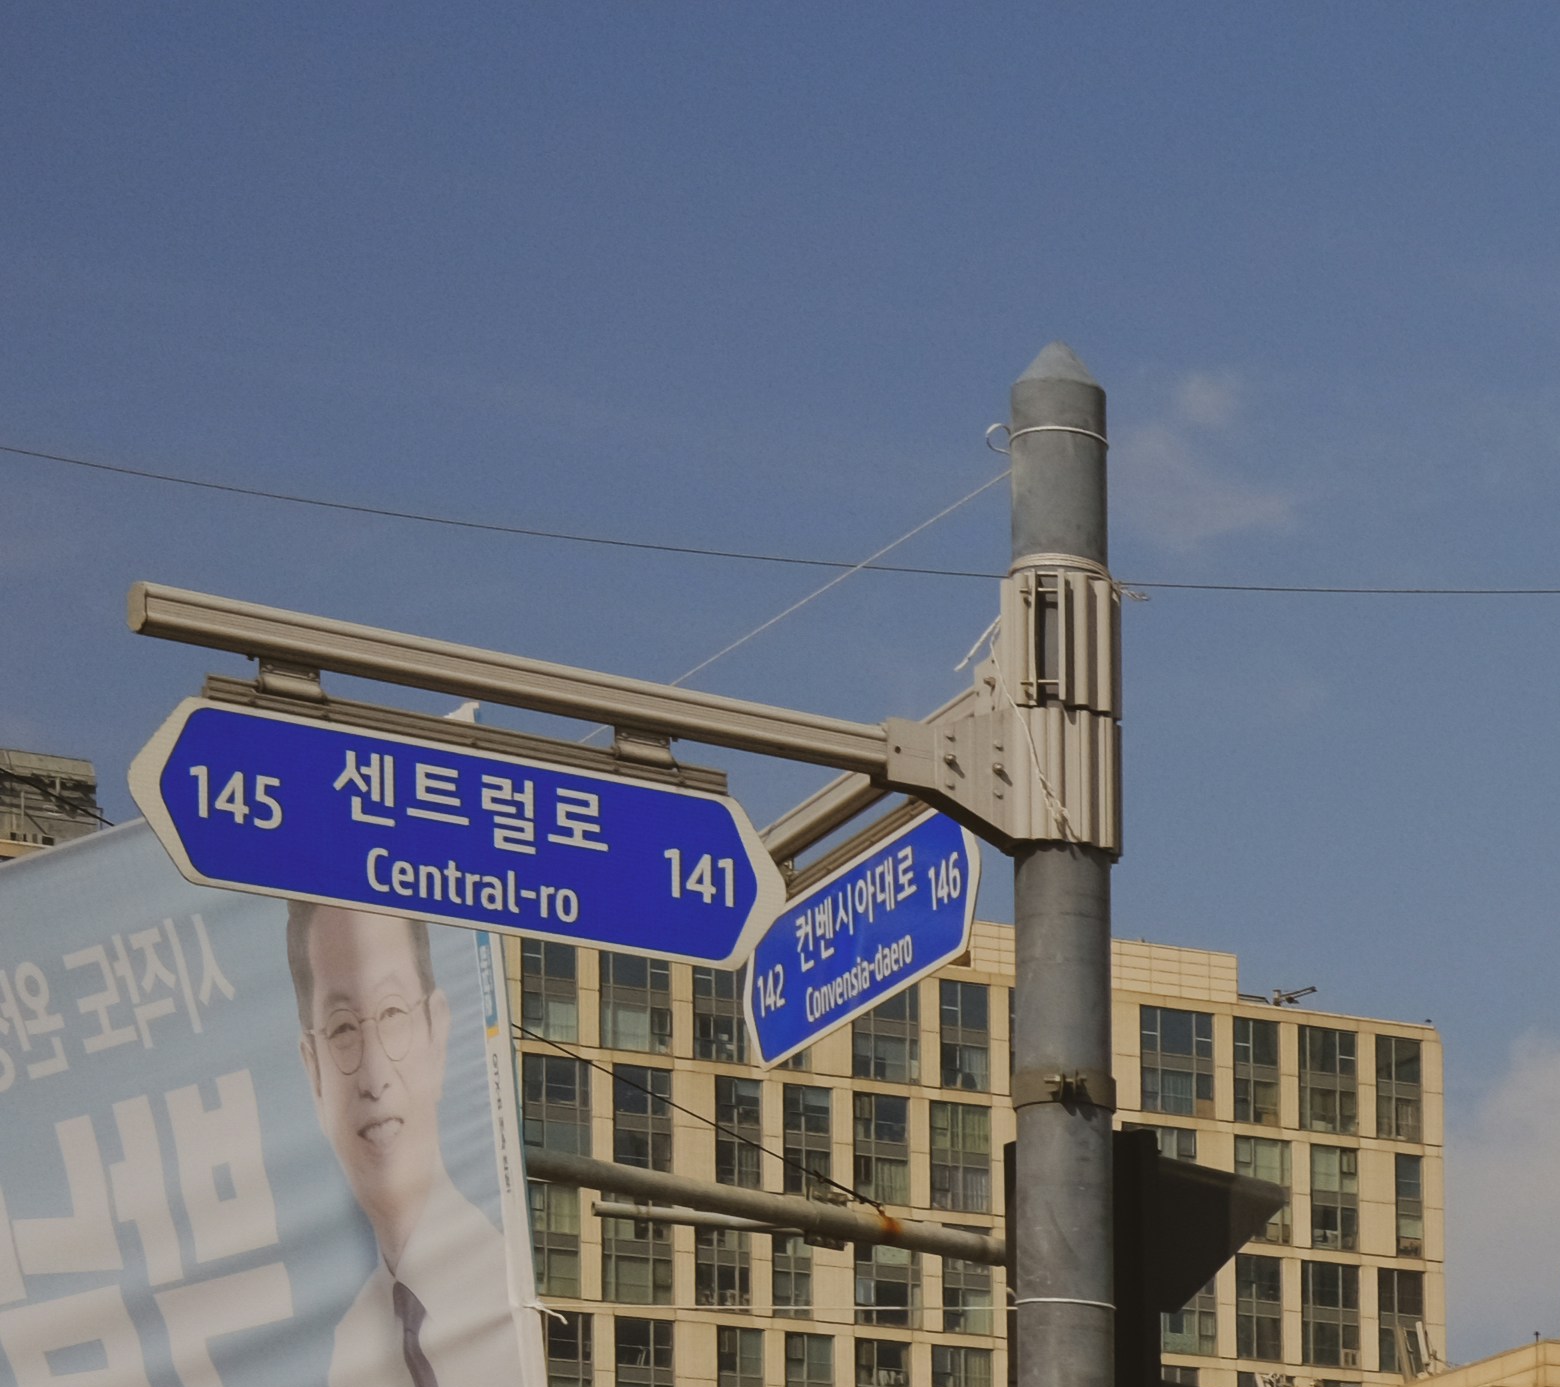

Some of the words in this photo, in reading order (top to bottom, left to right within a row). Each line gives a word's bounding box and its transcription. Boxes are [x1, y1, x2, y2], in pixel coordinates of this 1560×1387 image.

[189, 764, 284, 830] 145
[332, 748, 610, 855] 센트럴로
[663, 847, 735, 909] 141
[366, 847, 580, 924] Central-ro
[754, 963, 786, 1020] 142
[794, 845, 918, 965] 컨벤시아대로
[927, 852, 961, 914] 146
[804, 933, 913, 1024] Convensia-daero
